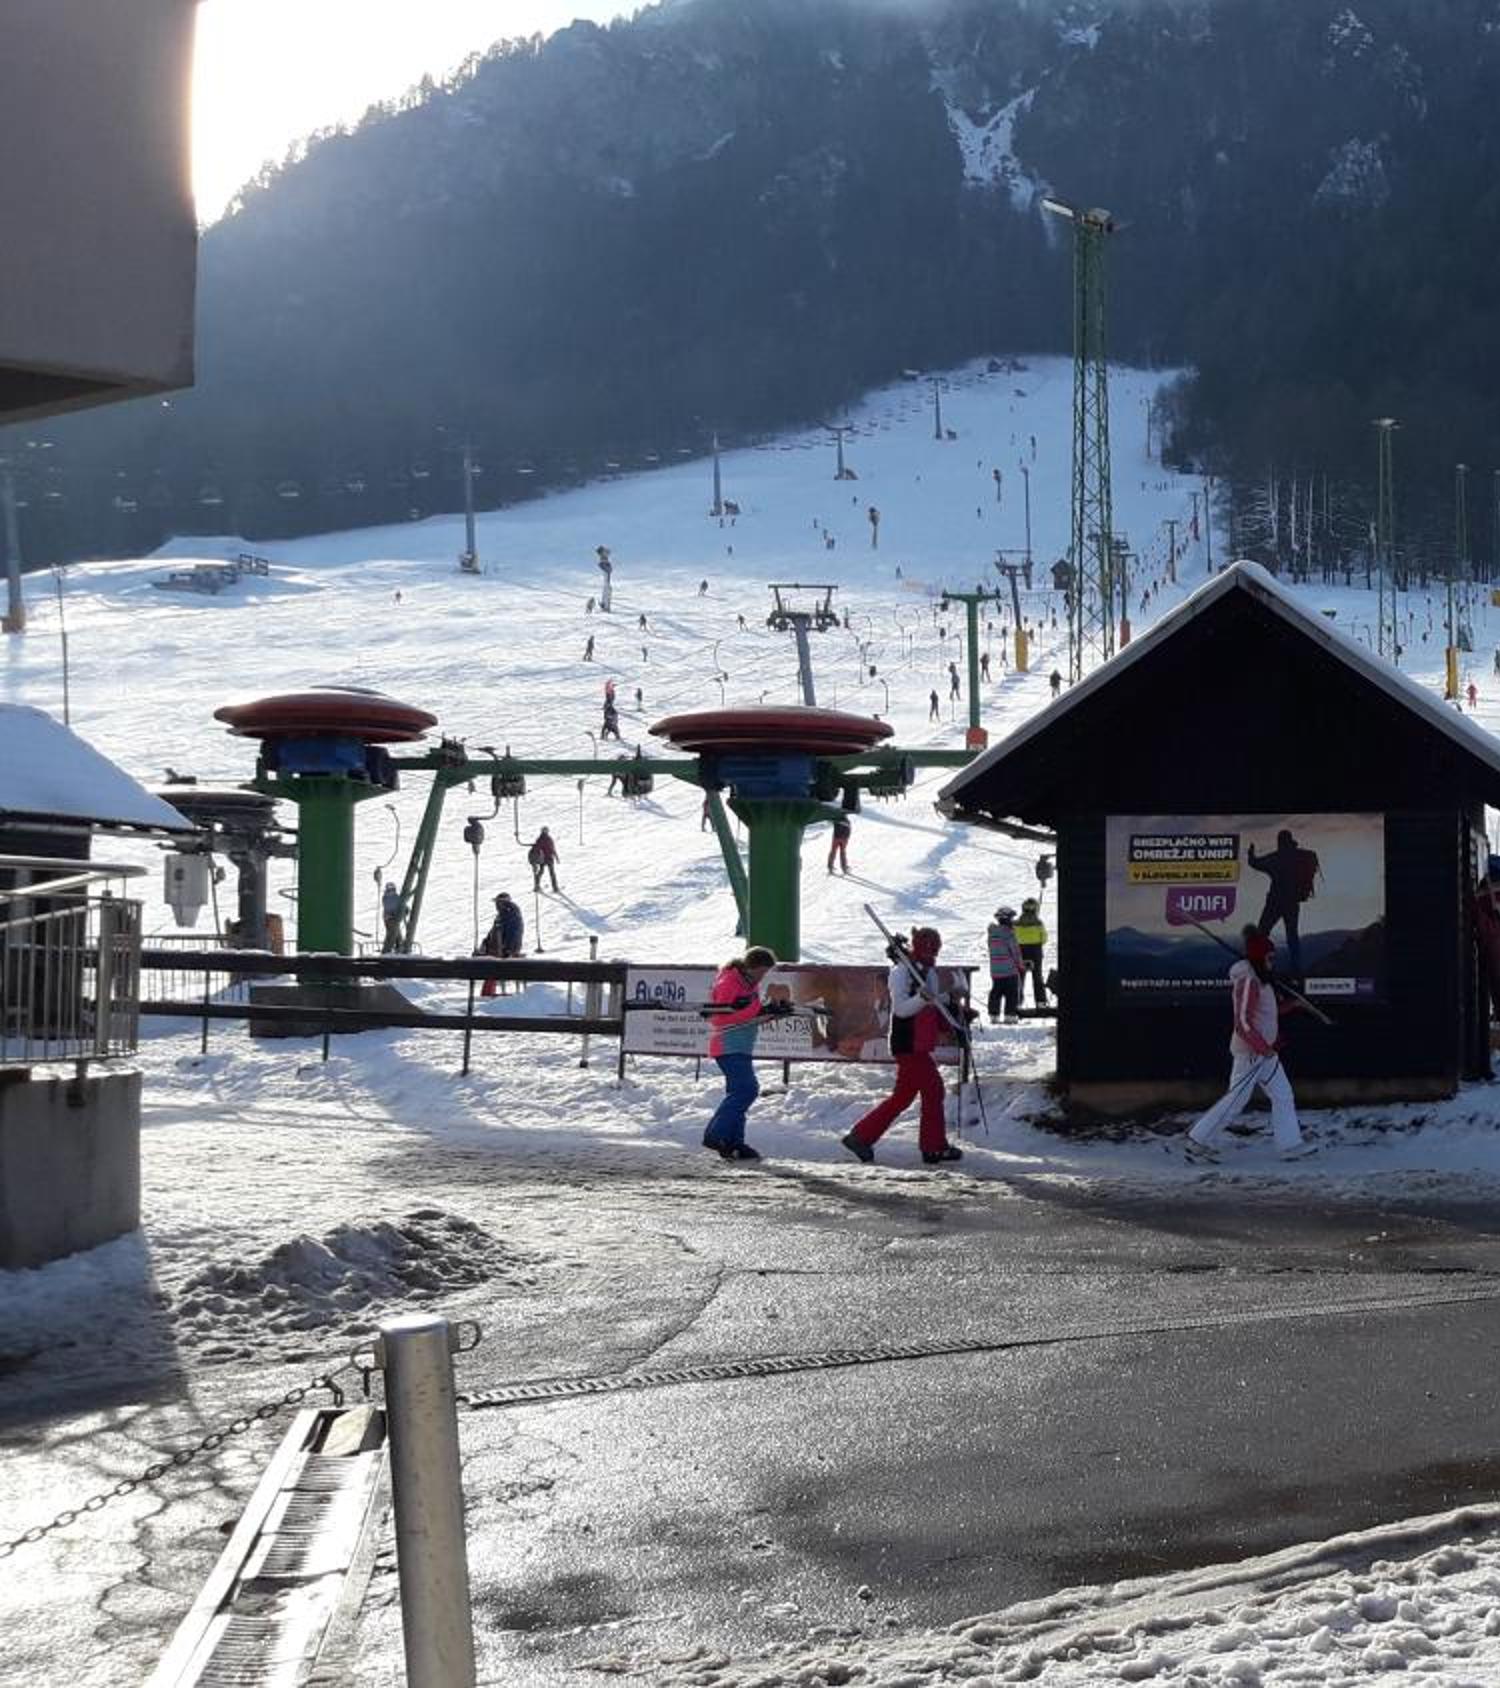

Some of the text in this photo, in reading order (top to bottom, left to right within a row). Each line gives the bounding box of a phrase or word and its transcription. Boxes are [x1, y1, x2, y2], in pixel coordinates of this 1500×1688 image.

[1208, 837, 1233, 846] WIFI
[1133, 848, 1233, 859] OMREŽJE UNIFI
[1181, 895, 1227, 911] UNIFI
